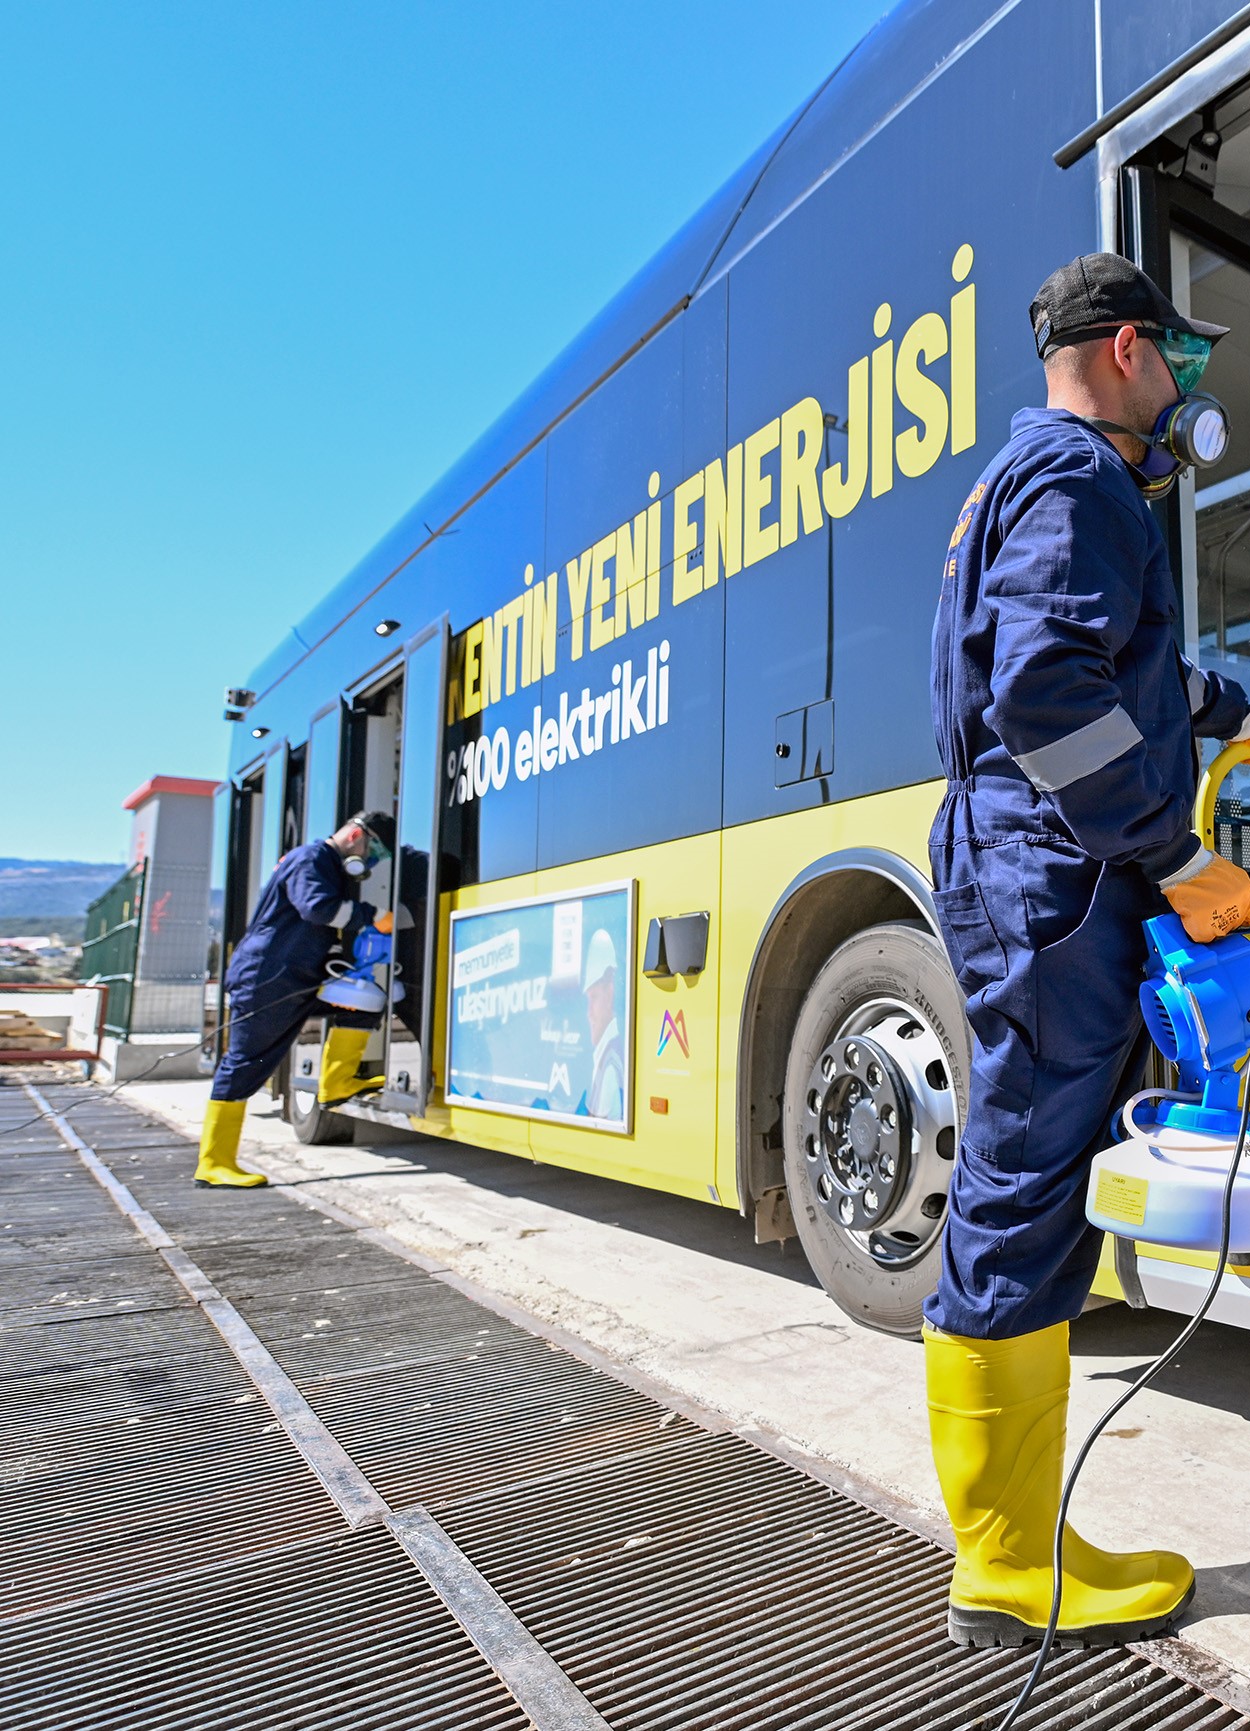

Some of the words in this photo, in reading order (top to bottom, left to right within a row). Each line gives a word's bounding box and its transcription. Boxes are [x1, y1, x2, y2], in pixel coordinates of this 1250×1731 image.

[447, 563, 558, 727] KENTİN
[566, 470, 661, 661] YENİ
[672, 243, 977, 606] ENERJİSİ
[447, 726, 510, 807] %100
[514, 639, 671, 782] elektrikli
[1111, 1176, 1126, 1185] UYARI
